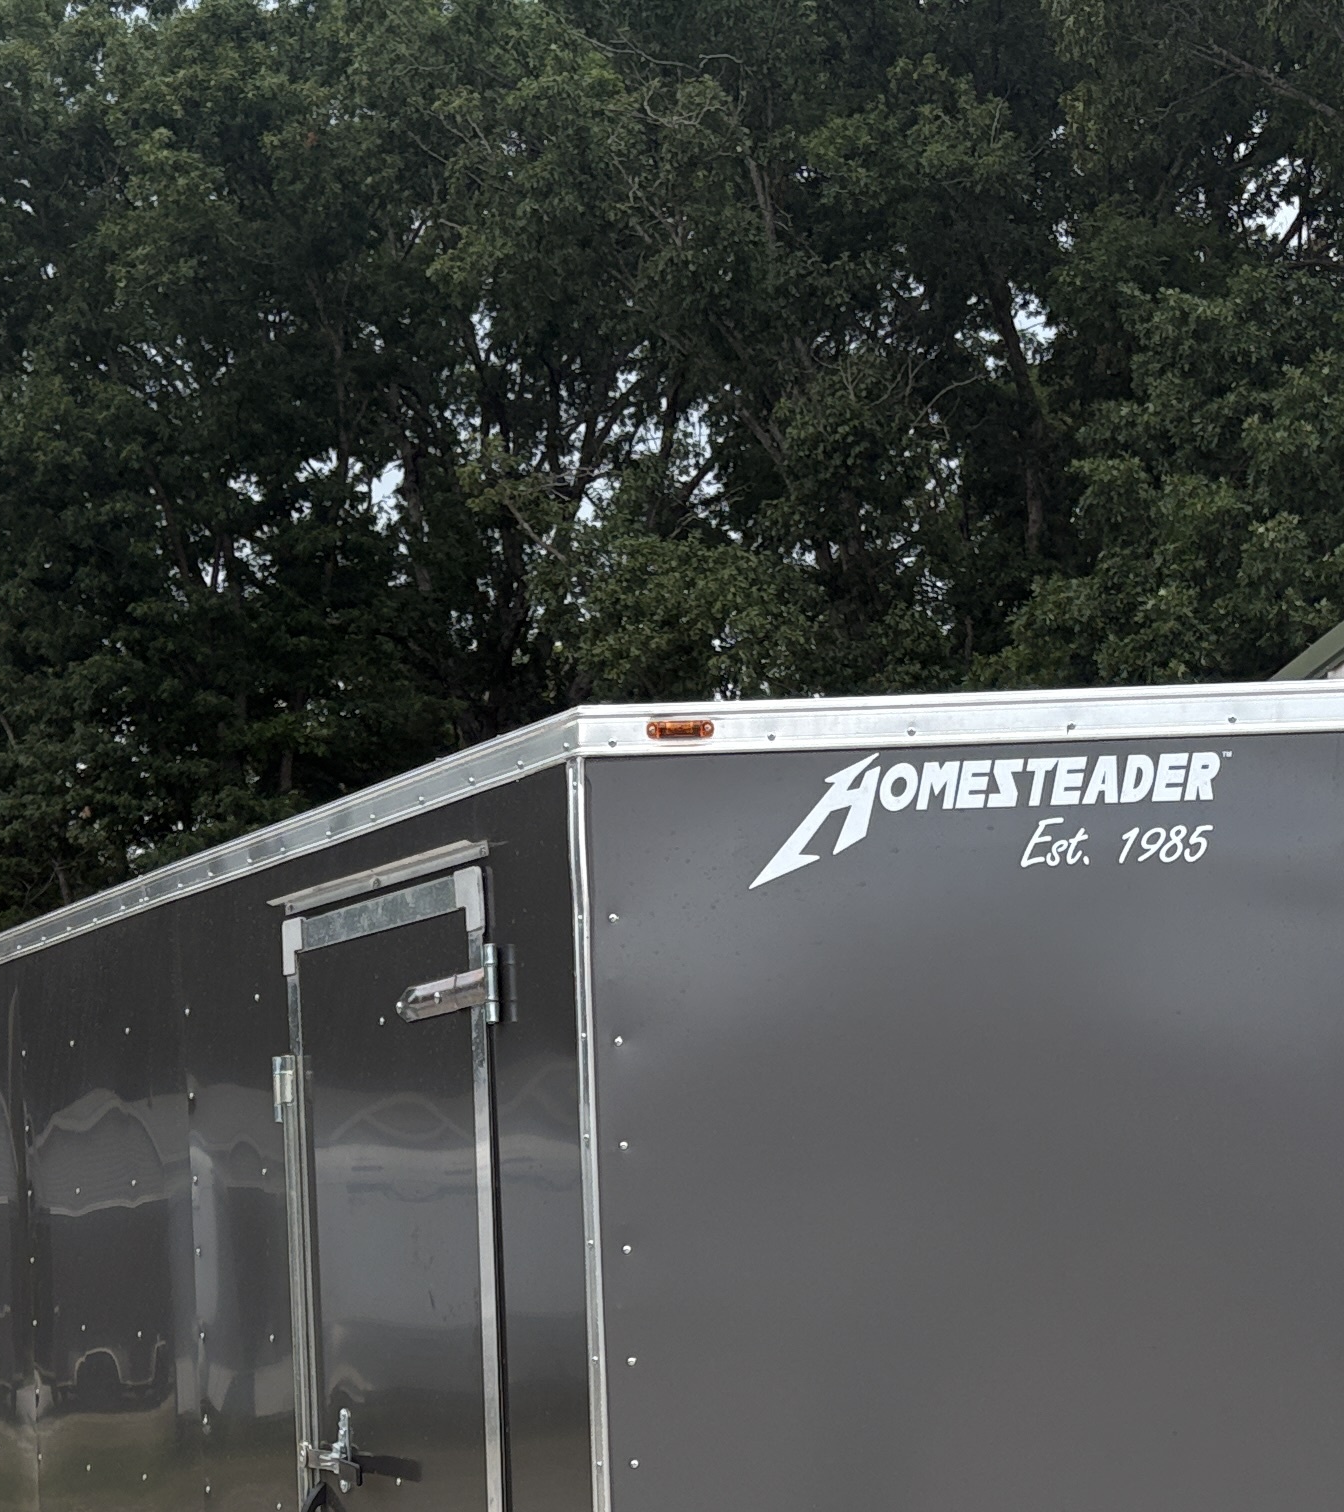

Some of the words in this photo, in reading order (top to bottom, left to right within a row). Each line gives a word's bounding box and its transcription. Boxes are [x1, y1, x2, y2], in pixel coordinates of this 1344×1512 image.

[748, 752, 1221, 889] HOMESTEADER
[1020, 816, 1090, 868] Est.
[1118, 823, 1214, 864] 1985
